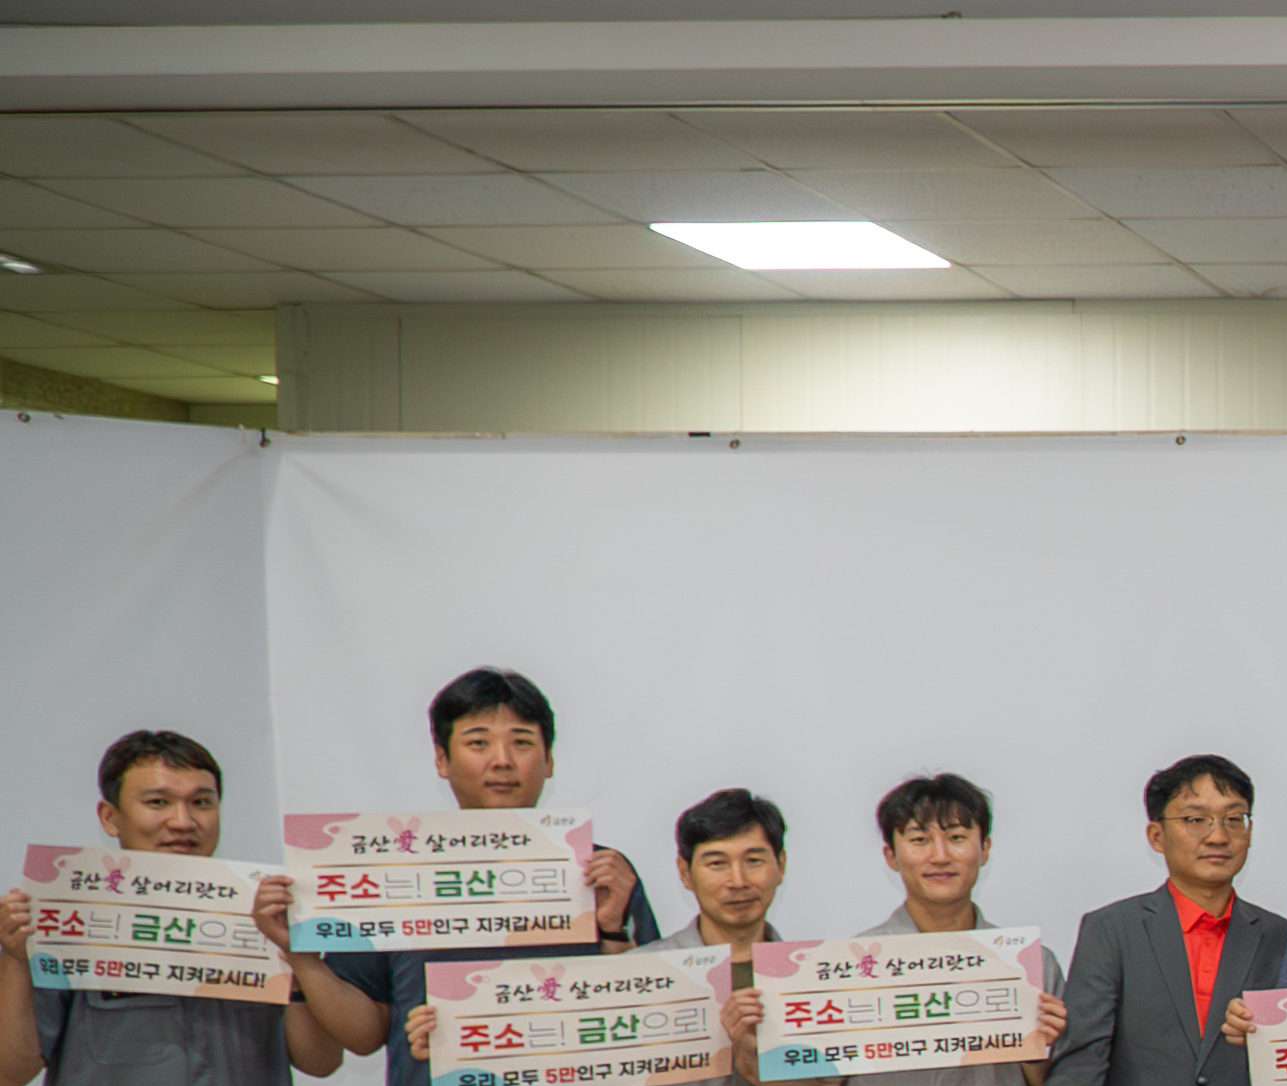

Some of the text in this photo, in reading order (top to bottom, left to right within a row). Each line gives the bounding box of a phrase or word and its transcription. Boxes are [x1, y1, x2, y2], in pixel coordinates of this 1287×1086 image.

[425, 832, 531, 852] 살어리랏다
[131, 875, 239, 899] 살어리랏다
[316, 868, 565, 901] 주소는! 금산으로!
[35, 908, 267, 951] 주소는! 금산으로!
[317, 914, 570, 939] 우리 모두 5만인구 지켜갑시다!
[63, 959, 89, 975] 모두
[94, 960, 160, 980] 5만인구
[166, 964, 266, 988] 지켜갑시다!
[886, 953, 985, 976] 살어리랏다
[570, 976, 675, 999] 살어리랏다
[783, 987, 1017, 1028] 주소는! 금산으로!
[459, 1010, 706, 1053] 주소는! 금산으로!
[785, 1032, 1022, 1065] 우리 모두 5만인구 지켜갑시다!
[545, 1063, 611, 1084] 5만인구
[618, 1054, 710, 1076] 지켜갑시다!
